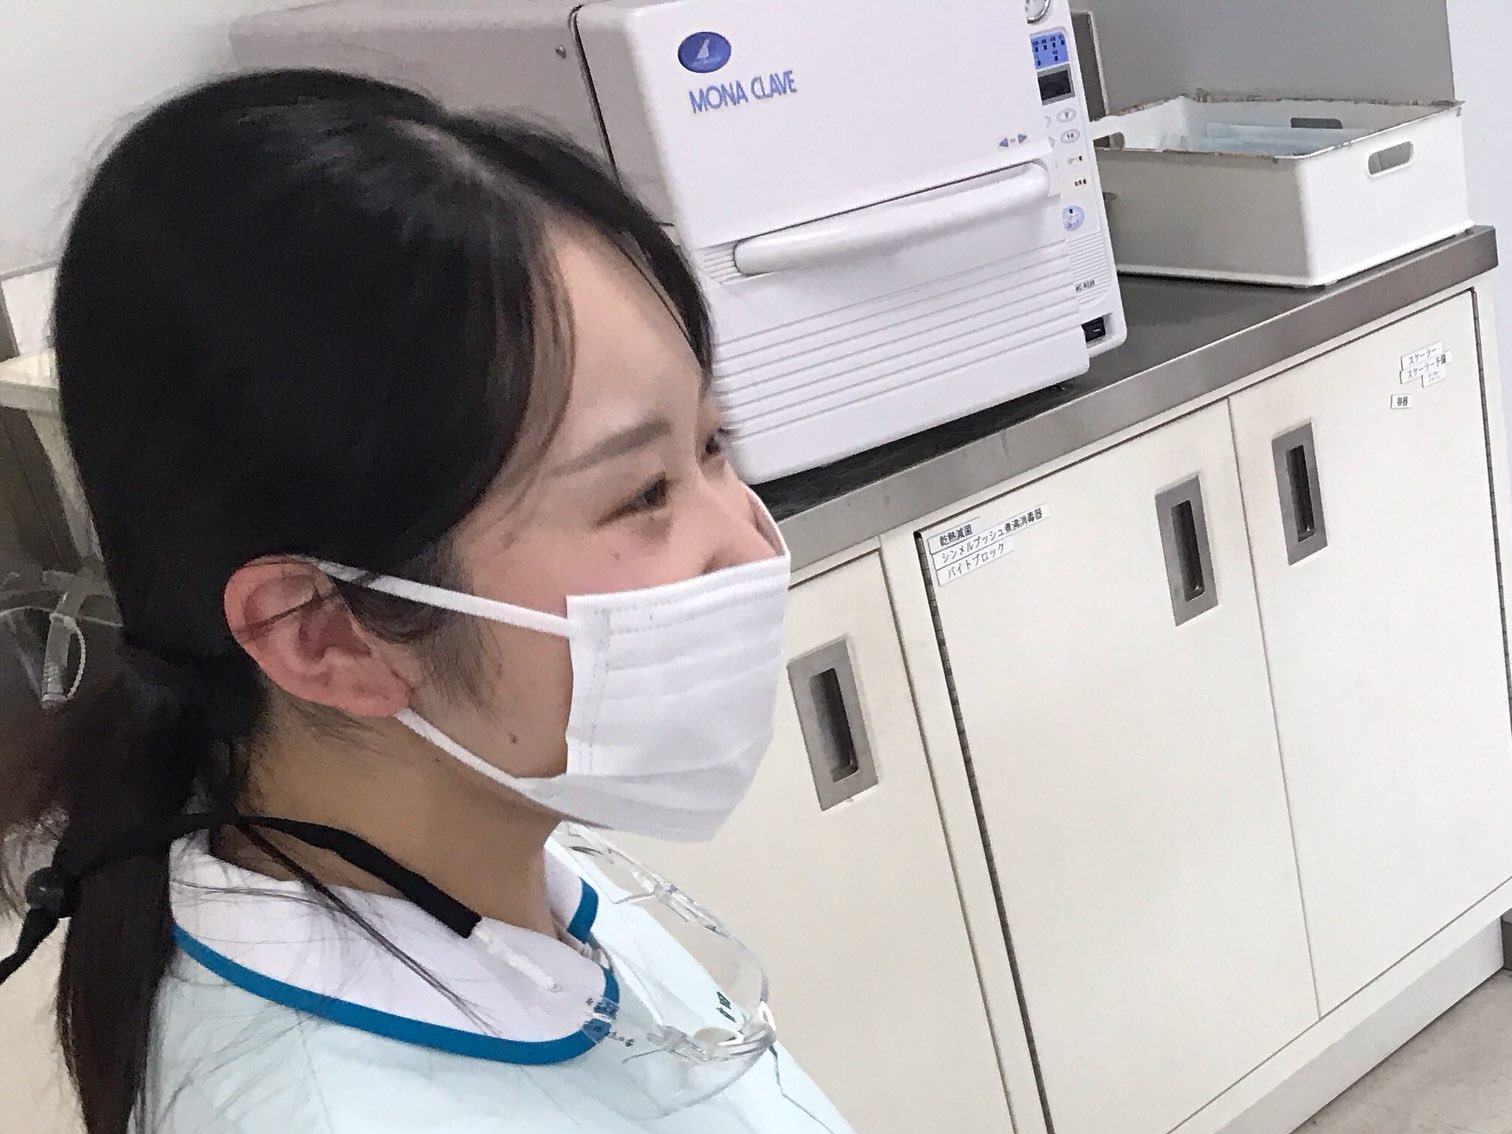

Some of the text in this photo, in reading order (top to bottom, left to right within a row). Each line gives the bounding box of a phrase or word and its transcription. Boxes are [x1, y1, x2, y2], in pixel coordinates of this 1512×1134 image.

[689, 70, 797, 113] MONA CLAVE
[948, 543, 1004, 578] バイトブロック
